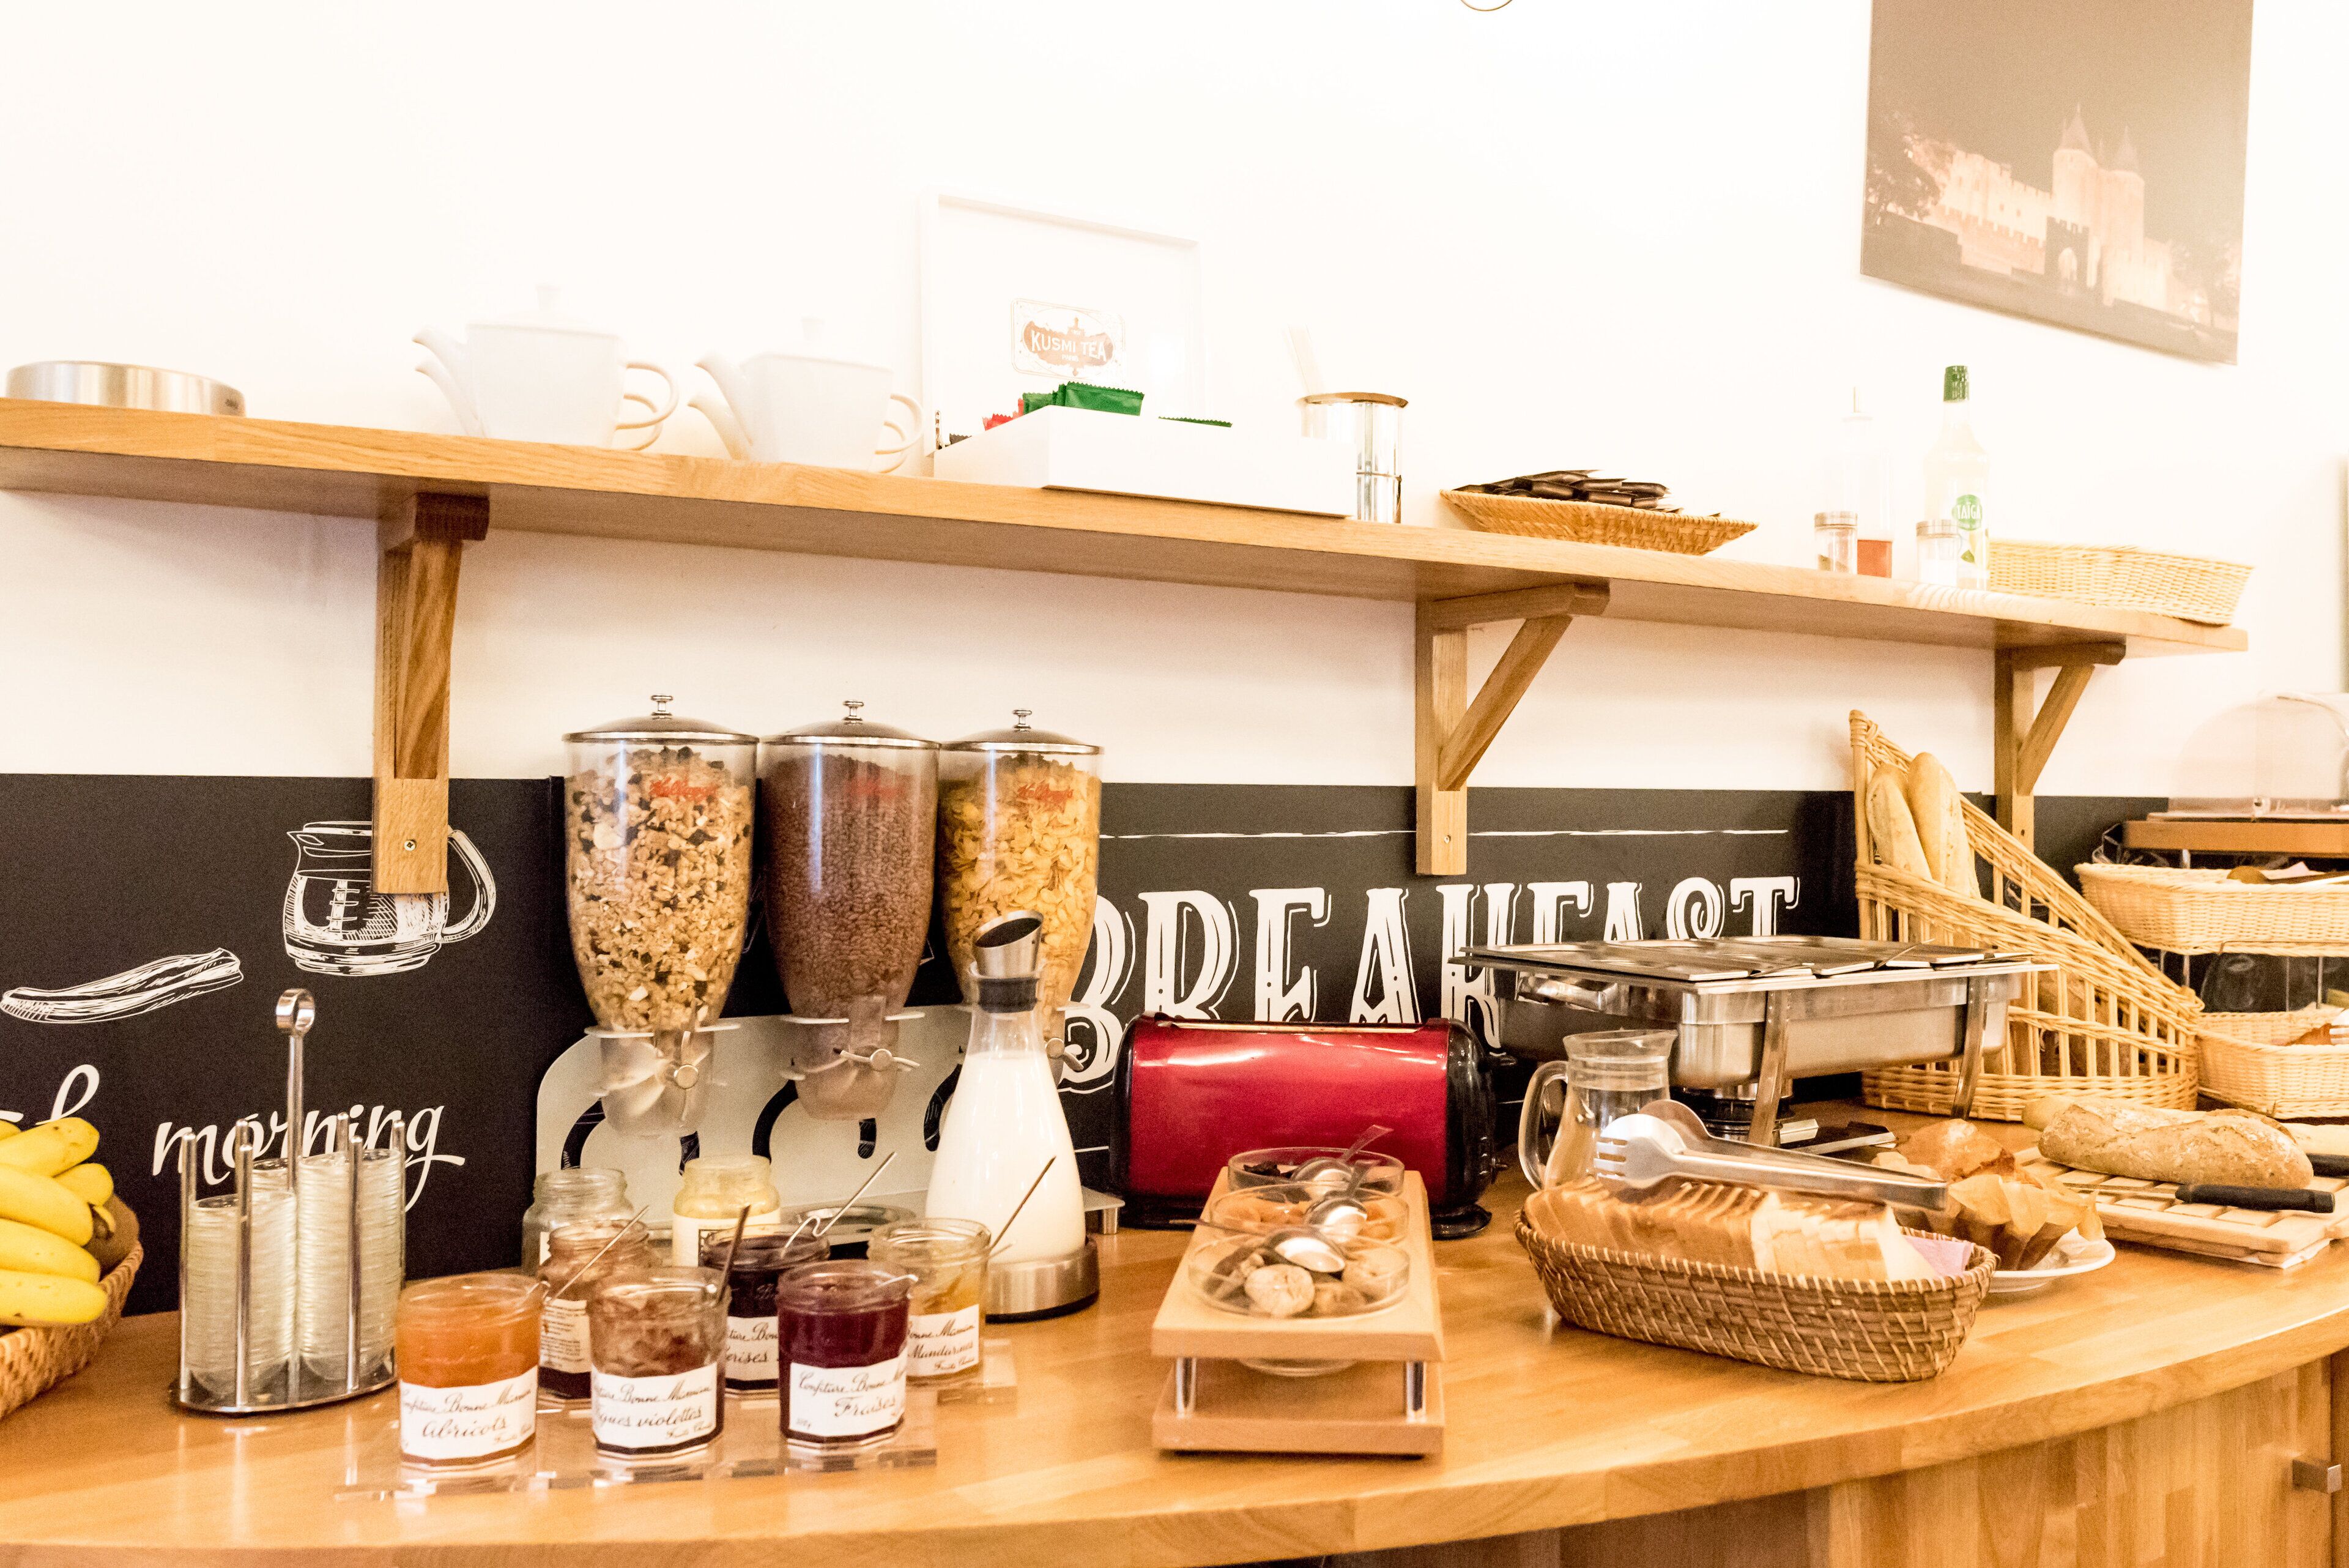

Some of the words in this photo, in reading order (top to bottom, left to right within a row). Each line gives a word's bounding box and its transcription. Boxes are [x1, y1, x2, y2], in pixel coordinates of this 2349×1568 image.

[1031, 330, 1076, 352] KUSMI
[1080, 340, 1107, 362] TEA
[152, 1104, 465, 1212] morning
[752, 1321, 779, 1341] Bon
[834, 1395, 897, 1418] Fraises
[597, 1411, 631, 1429] gues
